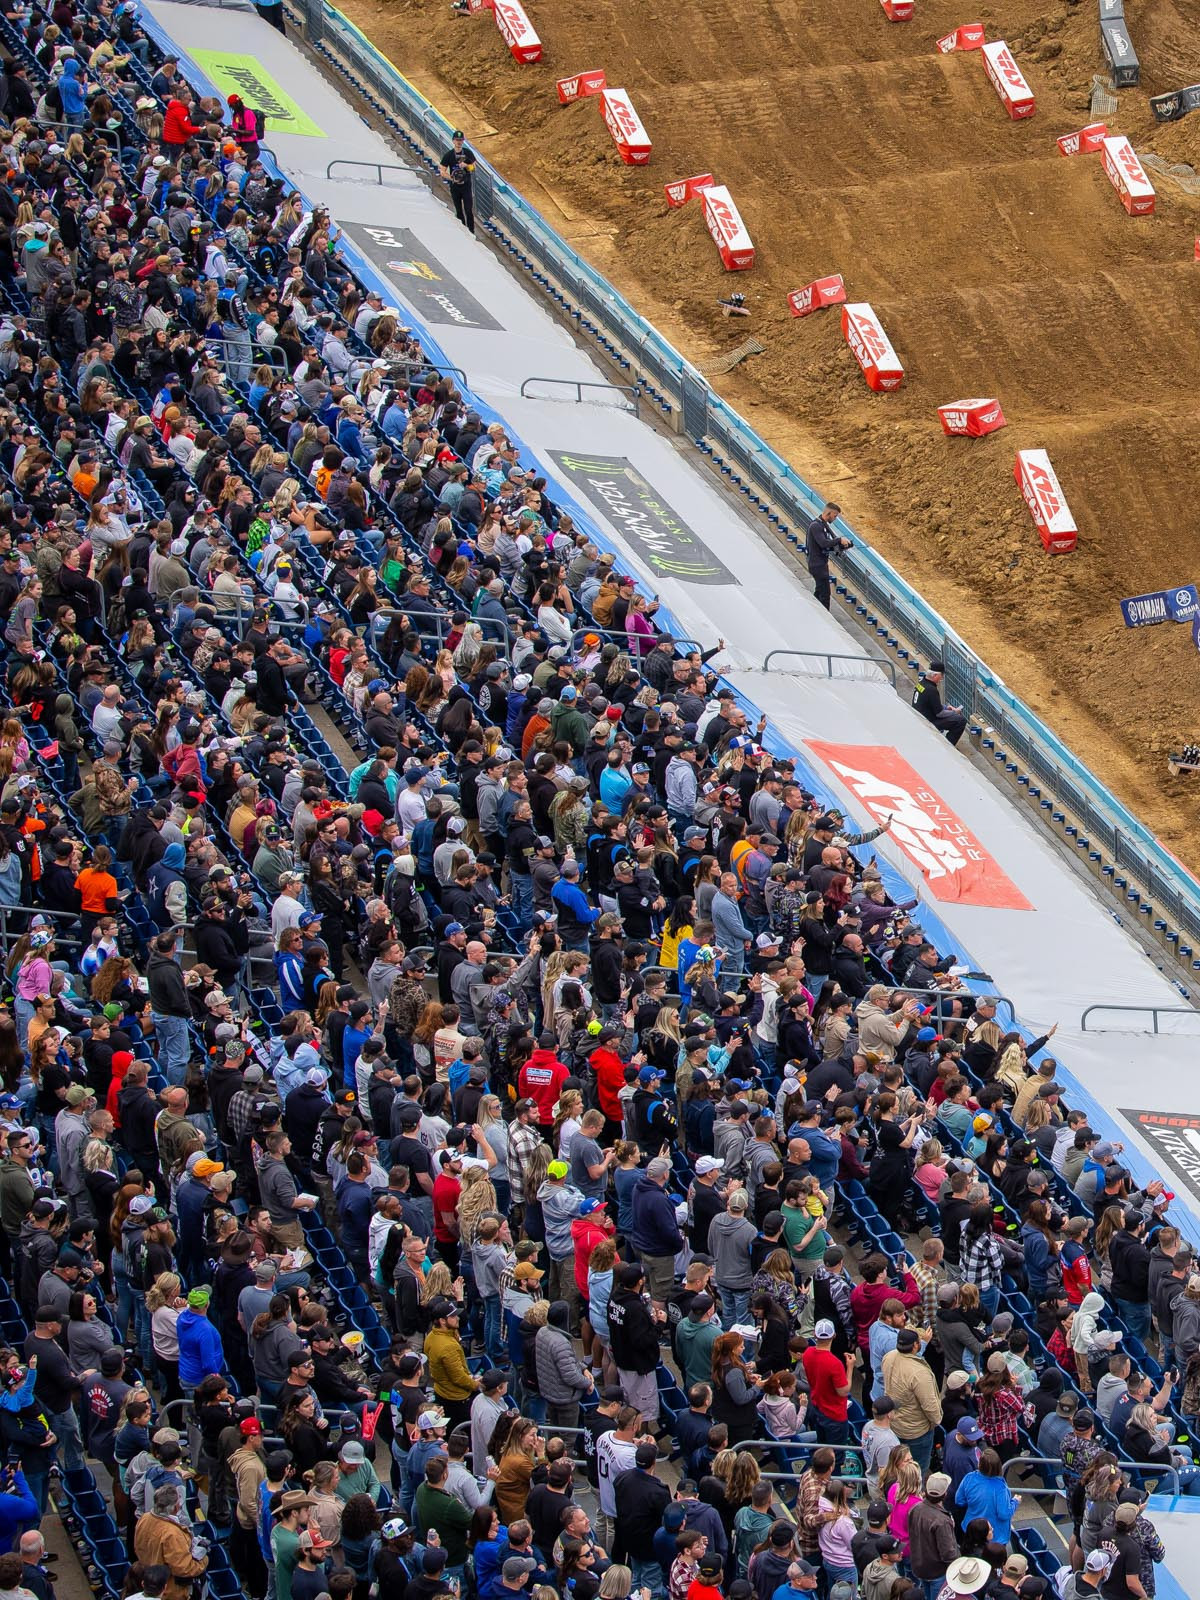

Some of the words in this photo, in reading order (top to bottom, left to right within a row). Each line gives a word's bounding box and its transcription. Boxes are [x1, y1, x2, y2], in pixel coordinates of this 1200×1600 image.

[996, 49, 1027, 90] FLY
[216, 63, 296, 122] Kawasaki
[610, 97, 637, 137] FLY
[1118, 143, 1147, 185] FLY
[710, 197, 740, 241] FLY
[852, 313, 888, 360] FLY
[943, 412, 968, 428] FLY
[1027, 461, 1061, 520] FLY
[587, 478, 674, 554] MONSTER
[637, 492, 693, 544] ENERGY
[1136, 597, 1167, 619] YAMAHA
[1176, 604, 1200, 618] YAMAHA
[829, 760, 967, 880] FLY
[916, 792, 987, 862] RACING
[1101, 1541, 1120, 1557] SEXTON
